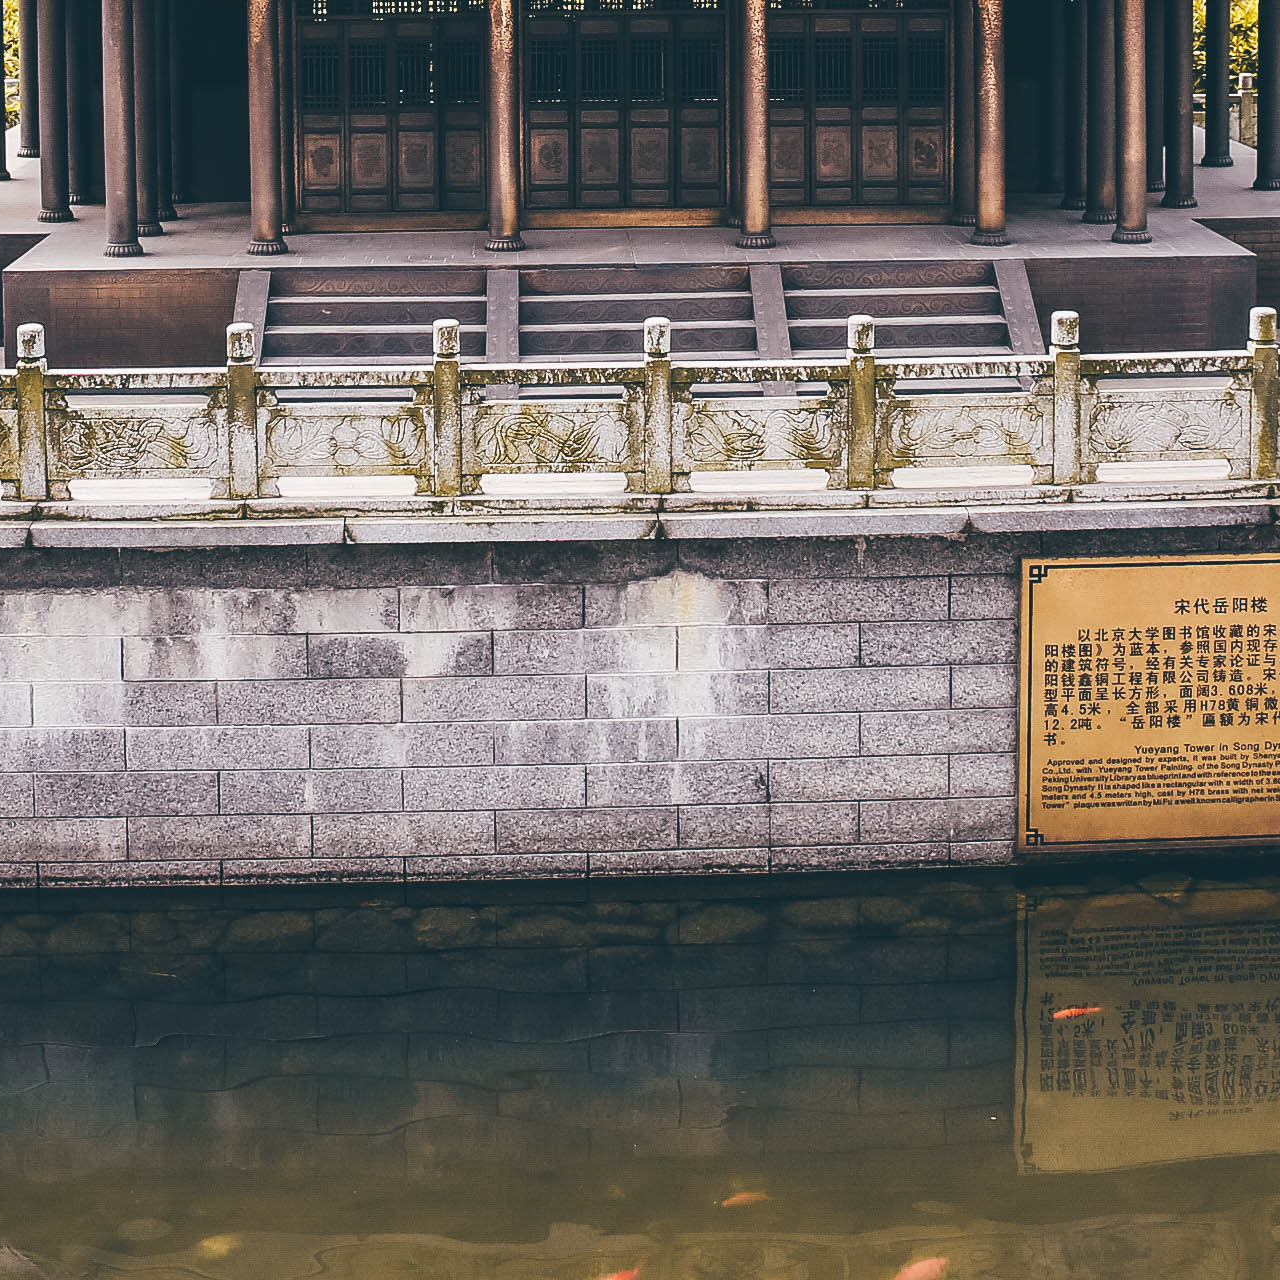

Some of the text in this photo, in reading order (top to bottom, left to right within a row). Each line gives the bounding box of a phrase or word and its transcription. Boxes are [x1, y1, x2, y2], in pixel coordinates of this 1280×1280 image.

[1174, 596, 1269, 615] 宋代岳阳楼
[1043, 733, 1066, 747] 书。
[1135, 745, 1179, 756] Yueyang
[1184, 743, 1216, 753] Tower
[1233, 742, 1260, 753] Song
[1047, 758, 1085, 767] Approved
[1088, 757, 1103, 765] and
[1106, 756, 1142, 766] designed
[1145, 756, 1154, 764] by
[1220, 753, 1237, 761] built
[1240, 753, 1249, 761] by
[1076, 766, 1092, 774] with
[1098, 765, 1132, 775] Yueyang
[1135, 764, 1158, 773] Tower
[1197, 762, 1205, 770] of
[1220, 761, 1240, 770] Song
[1242, 760, 1273, 769] Dynasty
[1042, 784, 1062, 793] Song
[1063, 783, 1095, 792] Dynasty
[1104, 782, 1111, 790] is
[1112, 781, 1140, 790] shaped
[1141, 780, 1156, 789] like
[1163, 779, 1206, 788] rectangular
[1208, 779, 1223, 787] with
[1233, 778, 1253, 786] width
[1256, 777, 1264, 785] of
[1041, 793, 1068, 801] meters
[1157, 789, 1173, 797] cast
[1177, 789, 1186, 797] by
[1189, 788, 1205, 796] H78
[1233, 786, 1248, 794] with
[1251, 786, 1263, 794] net
